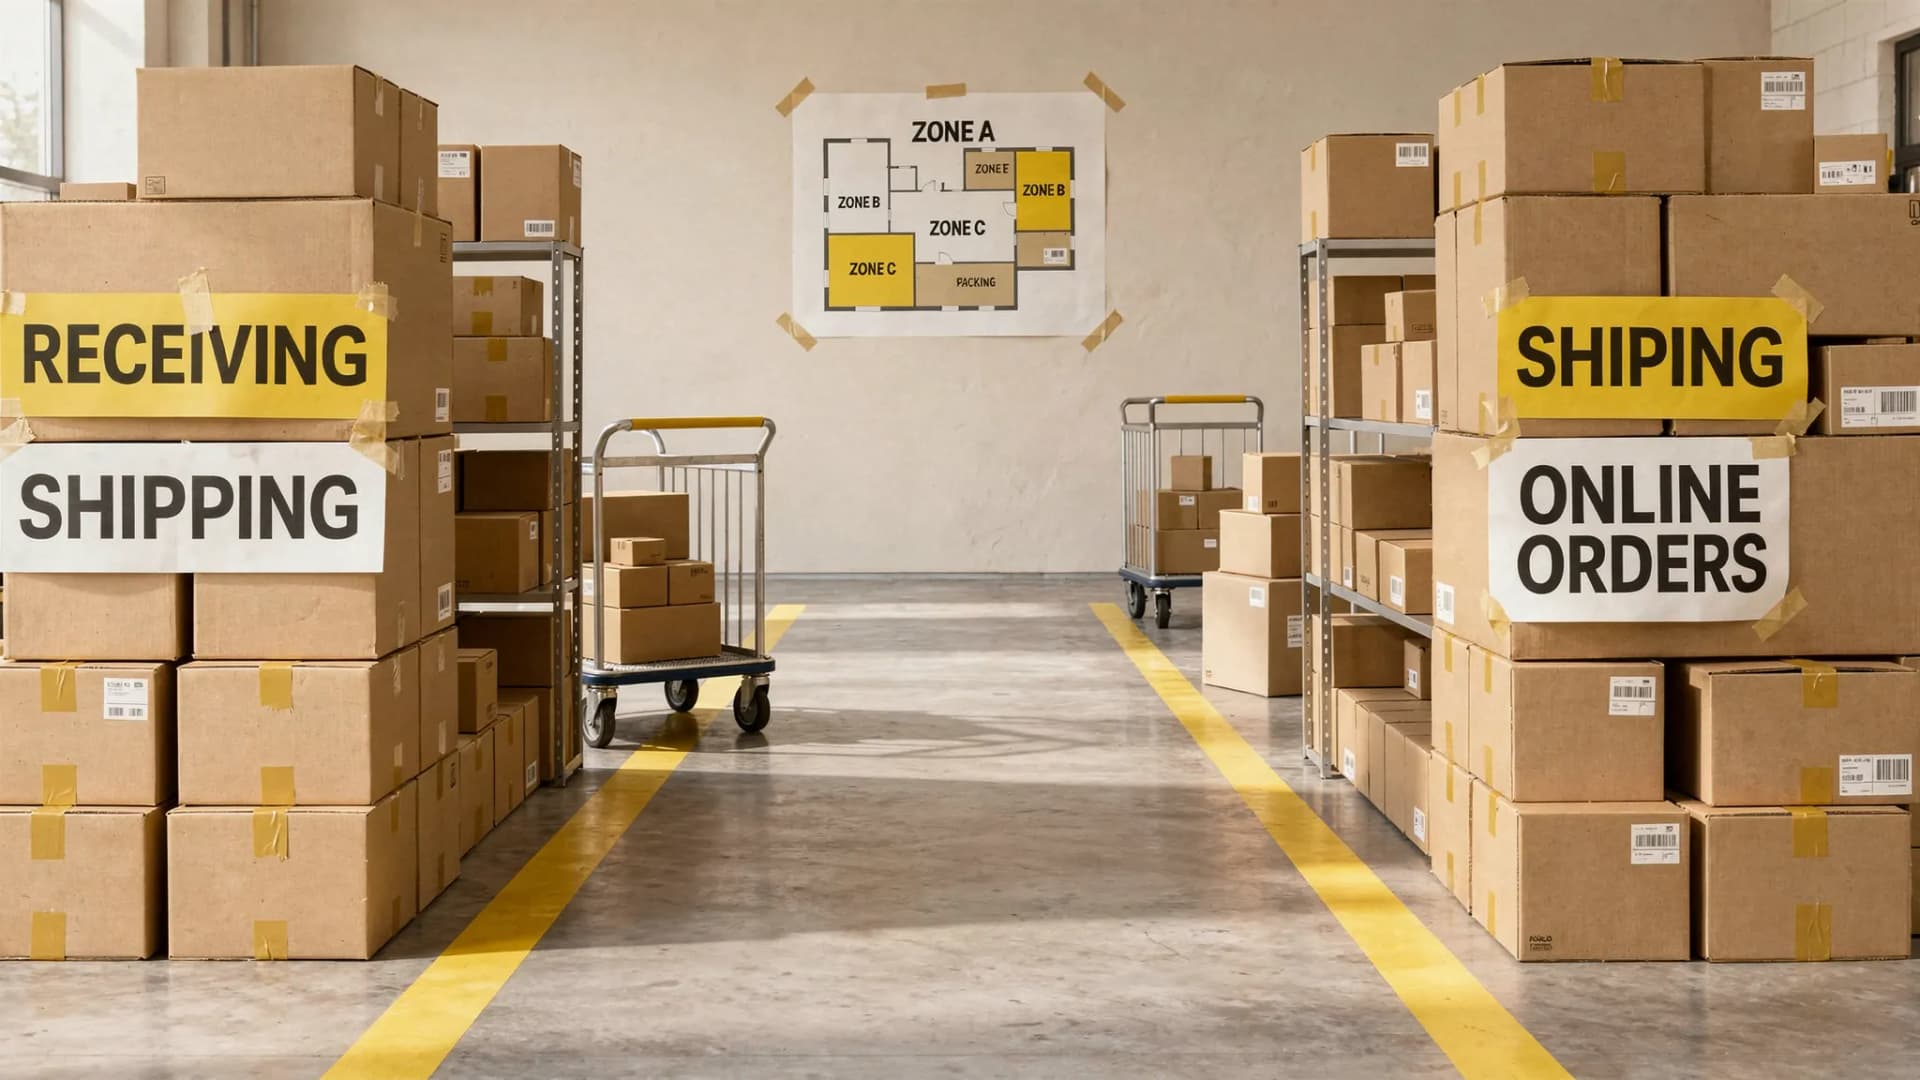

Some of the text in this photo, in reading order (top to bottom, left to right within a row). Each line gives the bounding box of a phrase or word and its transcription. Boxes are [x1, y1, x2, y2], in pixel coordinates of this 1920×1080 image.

[912, 120, 996, 143] ZONE A
[975, 163, 1009, 174] ZONE E
[1022, 184, 1066, 196] ZONE B
[838, 196, 881, 208] ZONE B
[929, 220, 986, 236] ZONE C
[850, 262, 897, 275] ZONE C
[956, 277, 996, 288] PACKING
[23, 323, 368, 387] RECEIVING
[1516, 325, 1783, 388] SHIPING
[1520, 464, 1761, 525] ONLINE
[19, 473, 359, 541] SHIPPING
[1517, 532, 1767, 595] ORDERS
